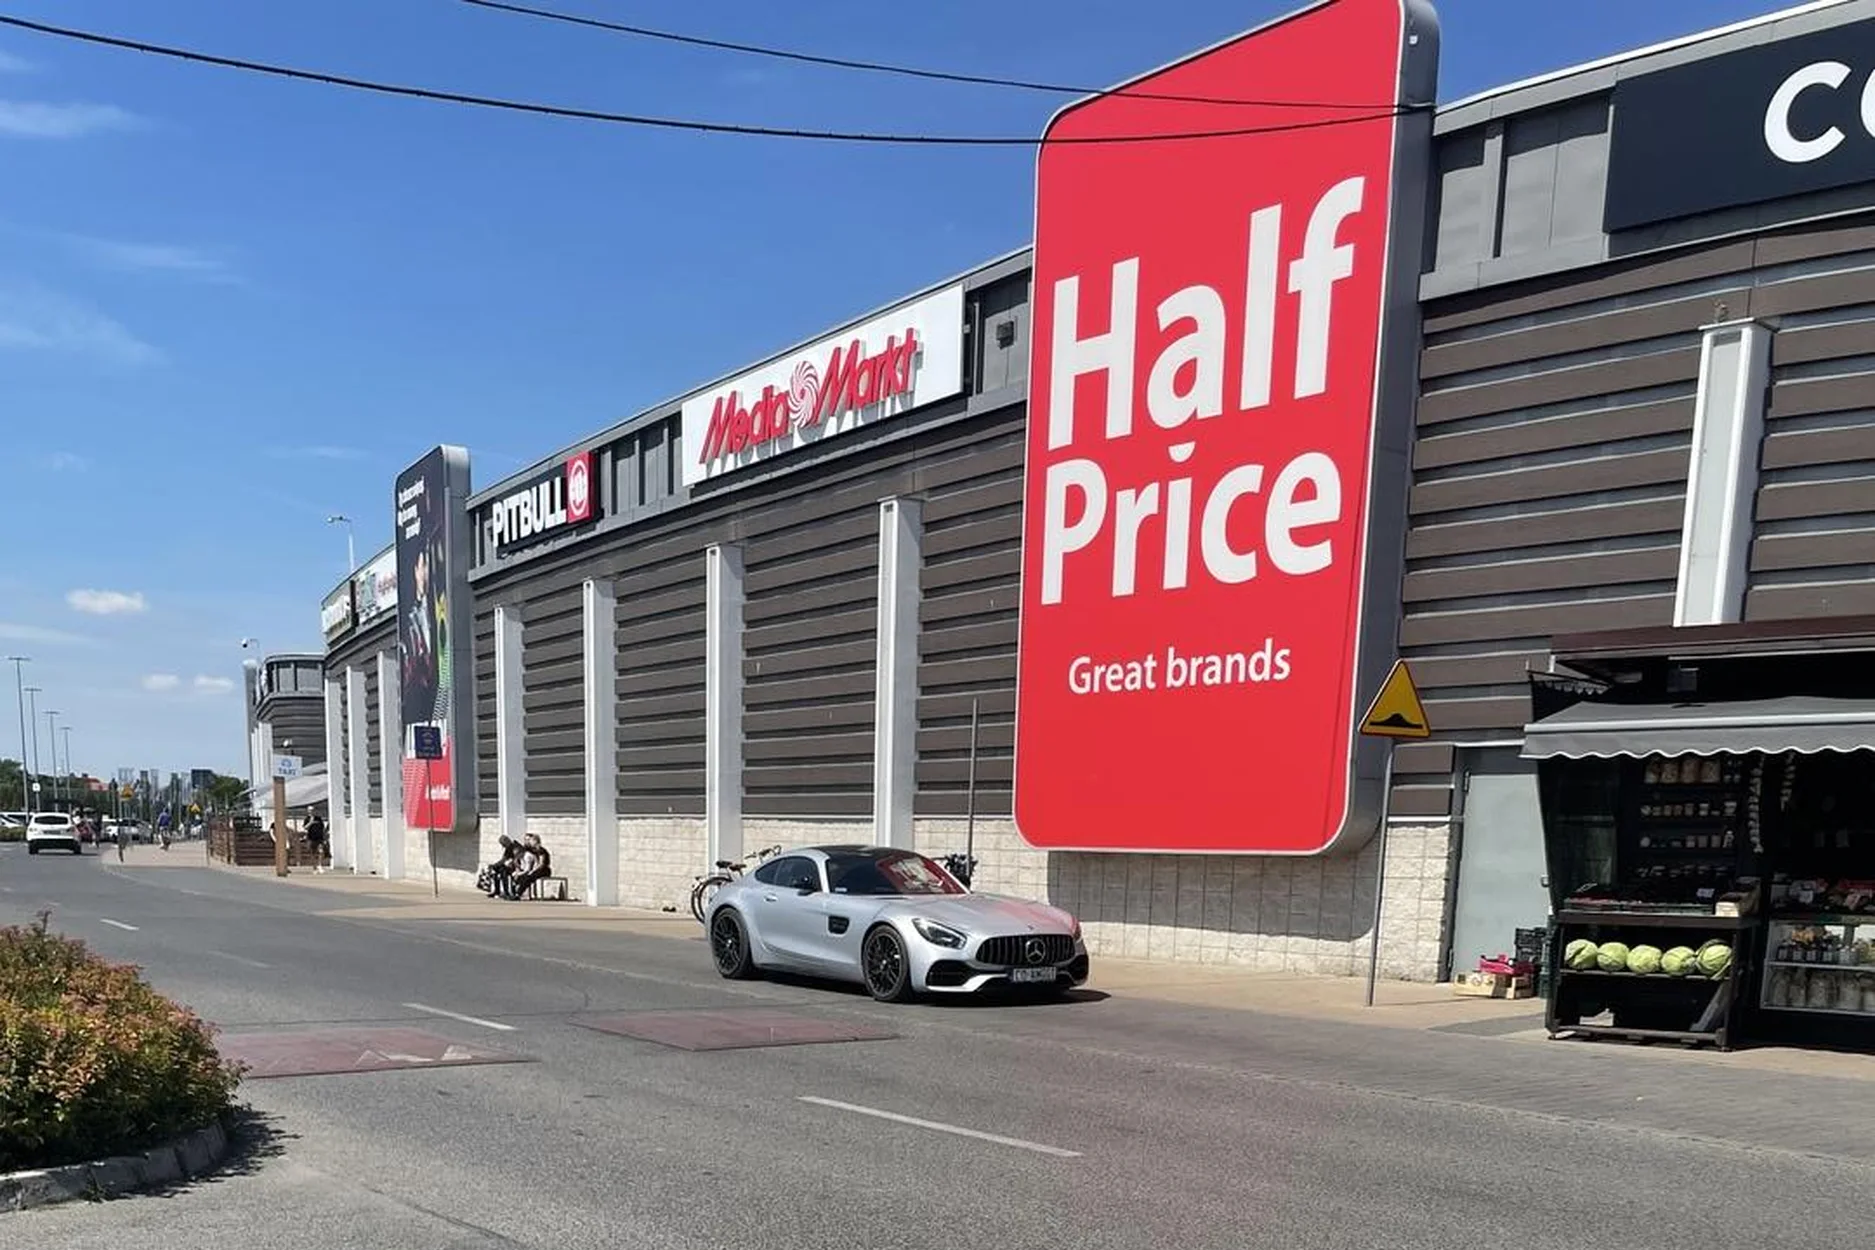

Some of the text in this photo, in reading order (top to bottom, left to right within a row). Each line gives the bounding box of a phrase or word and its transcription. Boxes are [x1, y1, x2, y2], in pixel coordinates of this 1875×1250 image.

[1764, 61, 1875, 163] C
[1048, 176, 1365, 451] Half
[699, 327, 918, 464] Media Markt
[492, 476, 567, 548] PITBULL
[1041, 441, 1342, 605] Price
[1069, 638, 1291, 694] Great brands
